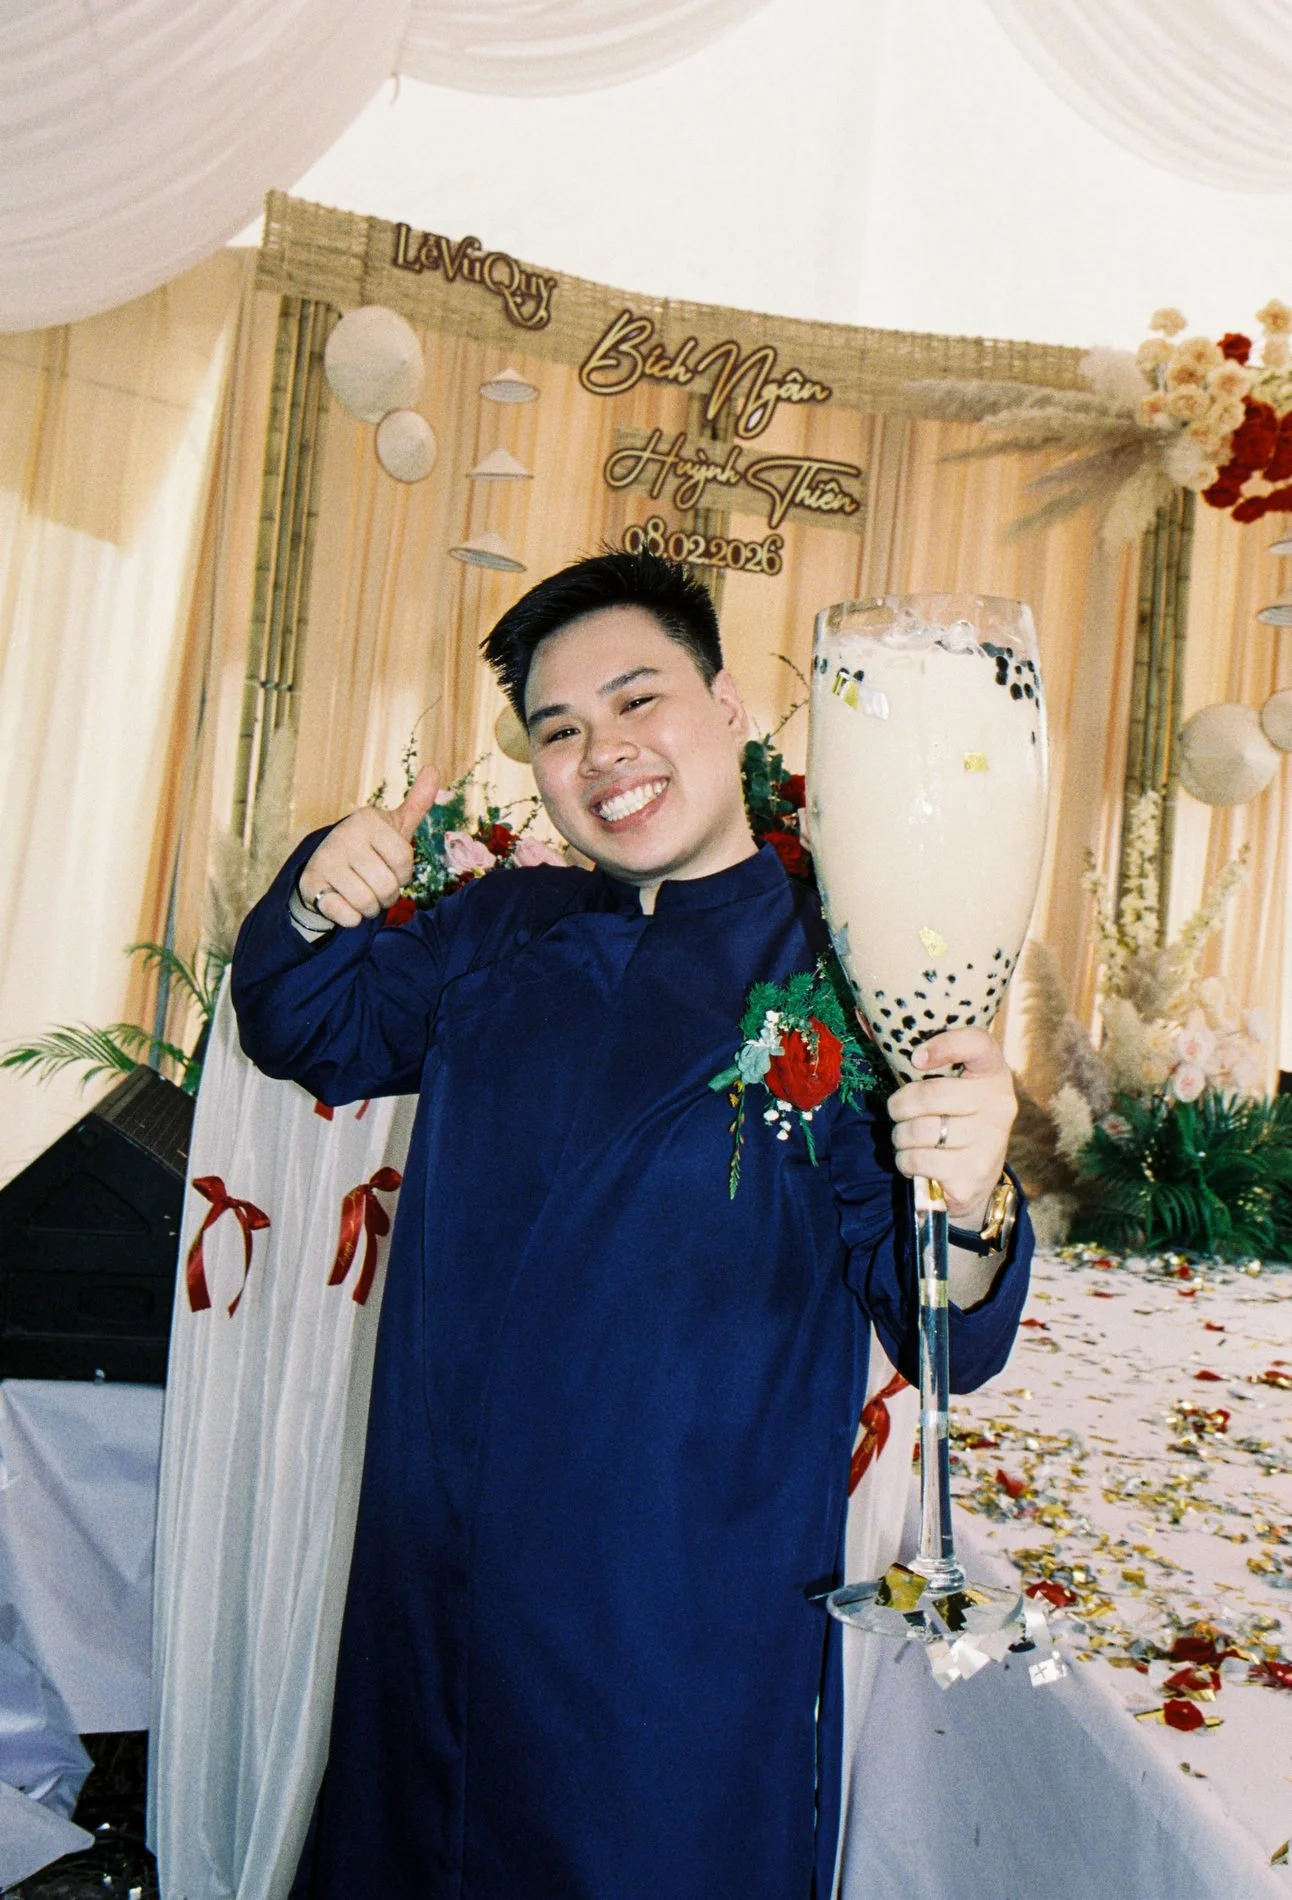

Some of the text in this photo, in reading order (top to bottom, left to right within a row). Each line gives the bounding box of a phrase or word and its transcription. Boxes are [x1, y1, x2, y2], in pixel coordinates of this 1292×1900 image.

[697, 341, 832, 439] Ngân
[604, 428, 862, 529] Huỳnh Thiên
